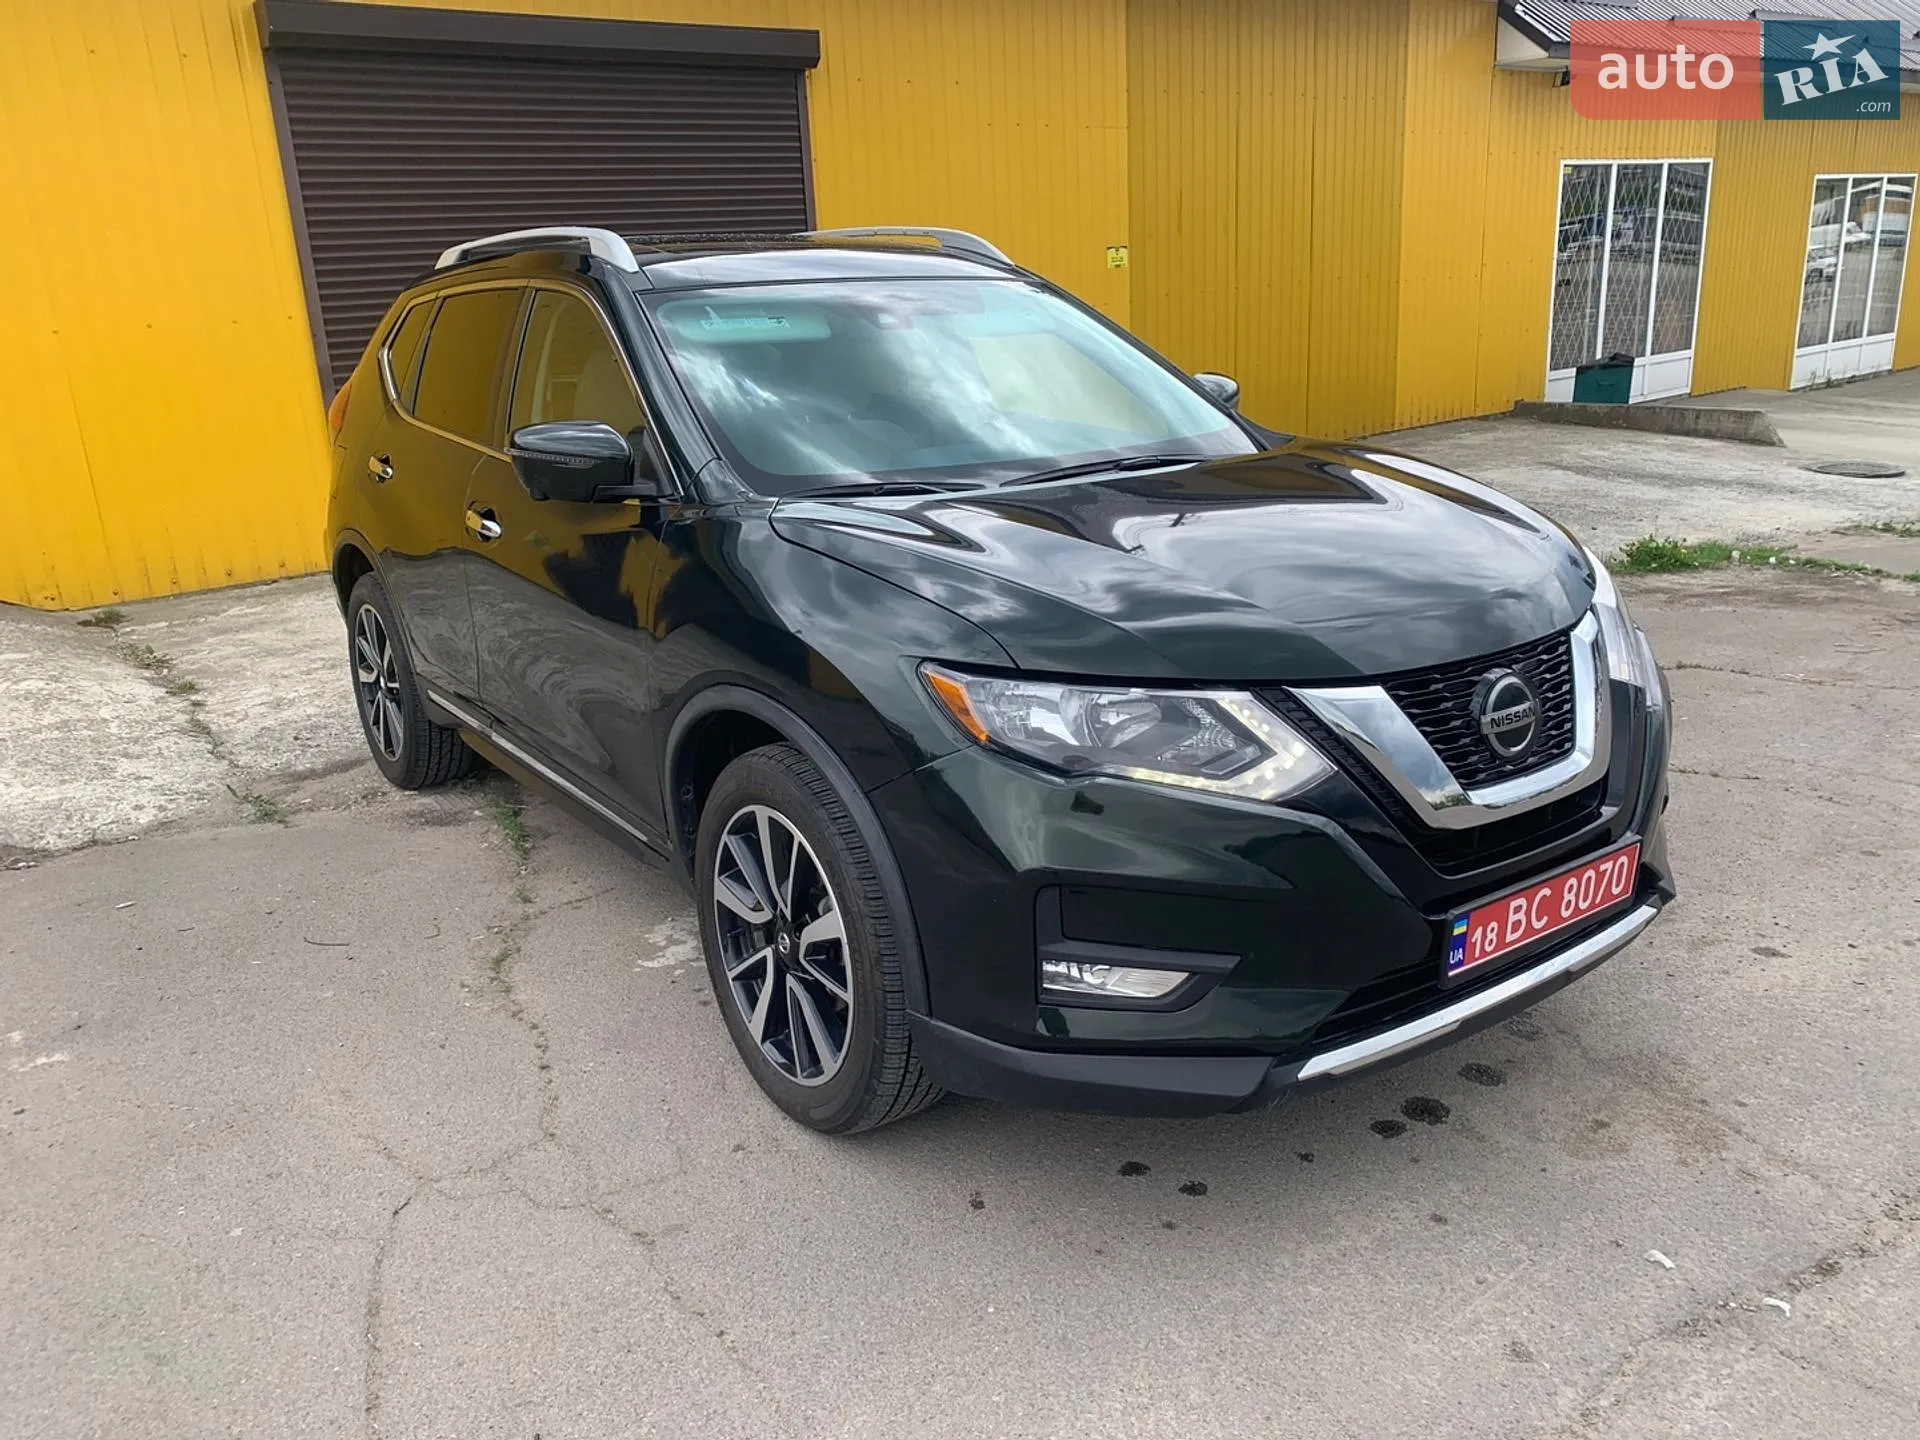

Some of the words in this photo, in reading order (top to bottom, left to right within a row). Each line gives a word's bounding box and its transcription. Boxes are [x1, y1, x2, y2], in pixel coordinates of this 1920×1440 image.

[1490, 706, 1535, 729] NISSAN
[1471, 921, 1498, 957] 18
[1505, 887, 1551, 943] BC
[1560, 855, 1629, 918] 8070
[1449, 948, 1464, 964] UA
